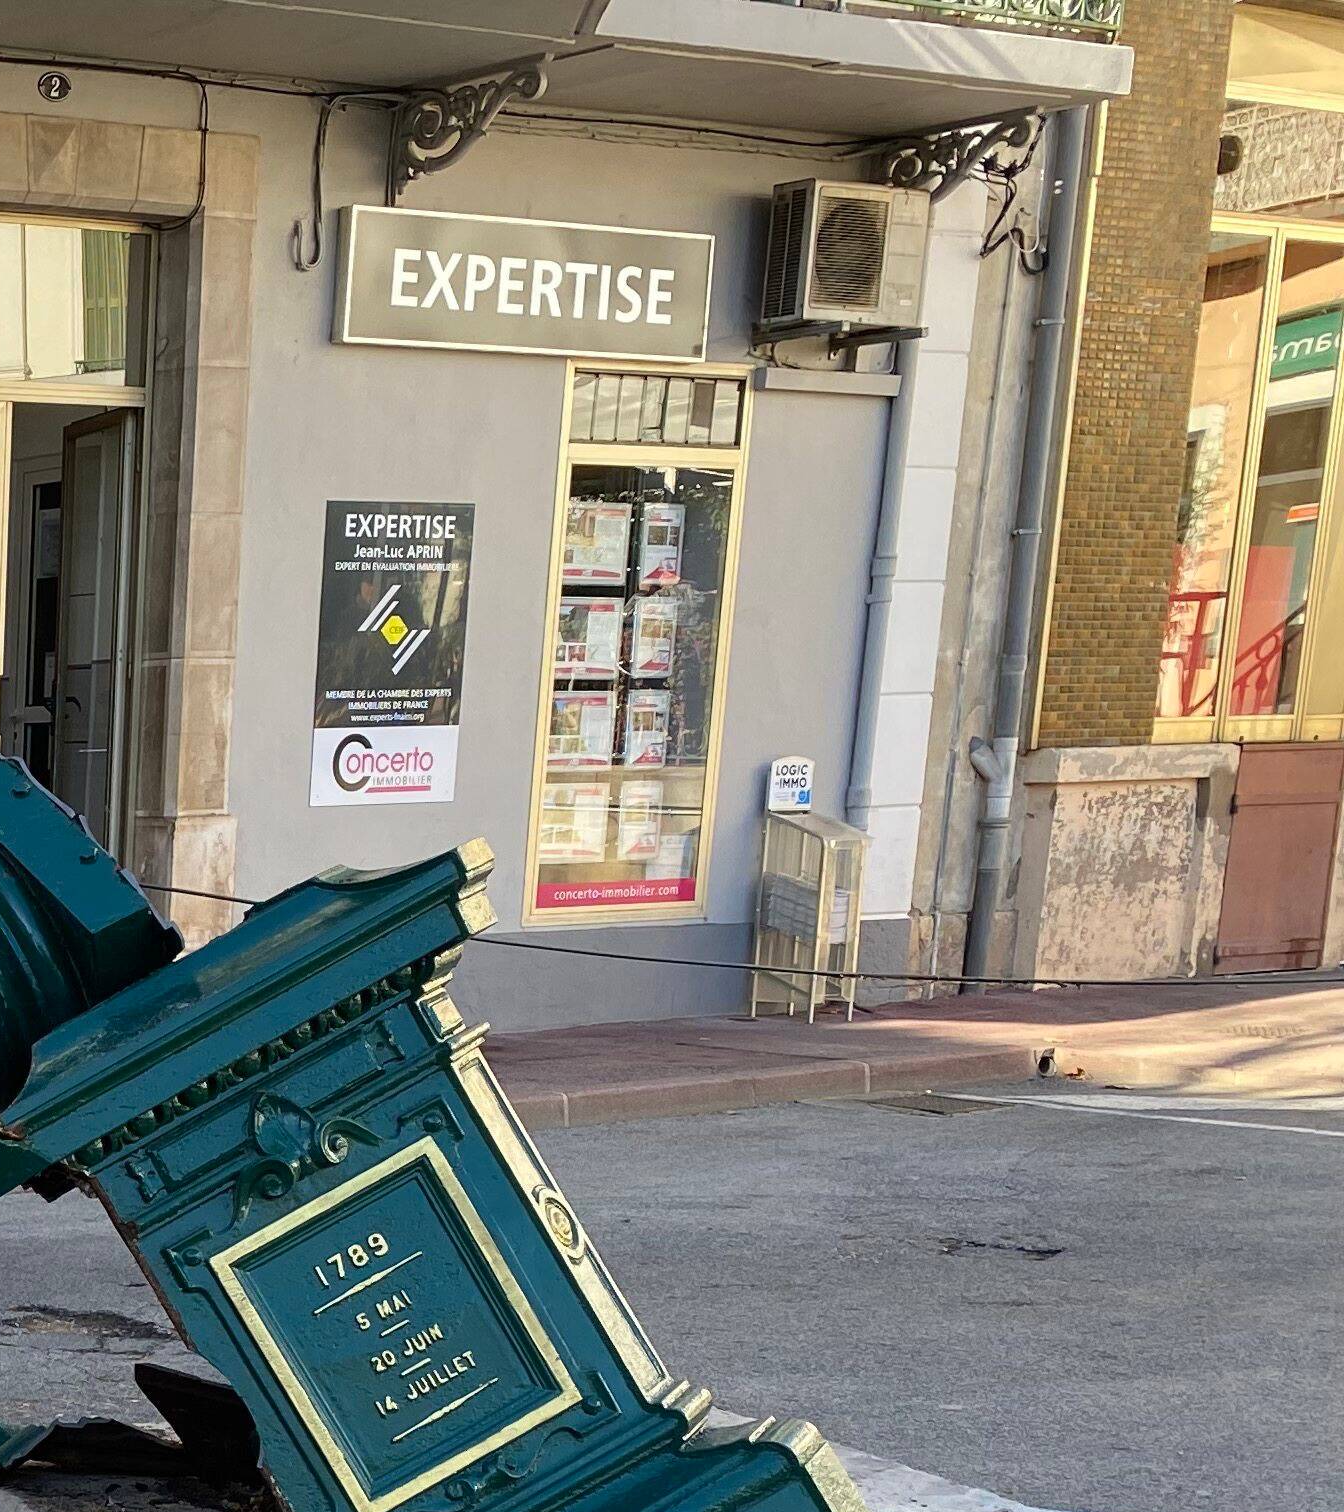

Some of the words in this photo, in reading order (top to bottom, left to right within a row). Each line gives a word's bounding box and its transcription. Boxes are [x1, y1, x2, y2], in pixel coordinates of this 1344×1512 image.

[50, 77, 61, 97] 2
[390, 247, 675, 325] EXPERTISE
[344, 512, 457, 540] EXPERTISE
[353, 544, 404, 560] Jean-Luc
[406, 544, 444, 559] APRIN
[325, 690, 355, 700] MEMBRE
[356, 690, 366, 699] DE
[366, 689, 376, 699] LA
[377, 689, 410, 698] CHAMBRE
[410, 688, 424, 698] DES
[424, 688, 452, 698] EXPERTS
[348, 701, 392, 711] IMMOBILIERS
[392, 700, 402, 710] DE
[402, 700, 429, 709] FRANCE
[332, 733, 433, 792] Concerto
[776, 764, 809, 776] LOGIC
[372, 775, 433, 786] IMMOBILIER
[554, 884, 679, 901] concerto-immobilier.com
[313, 1232, 390, 1288] 1789
[355, 1312, 371, 1331] 5
[374, 1289, 413, 1321] MAI
[370, 1351, 397, 1374] 20
[402, 1322, 445, 1357] JUIN
[375, 1394, 399, 1418] 14
[405, 1350, 477, 1401] JUILLET
